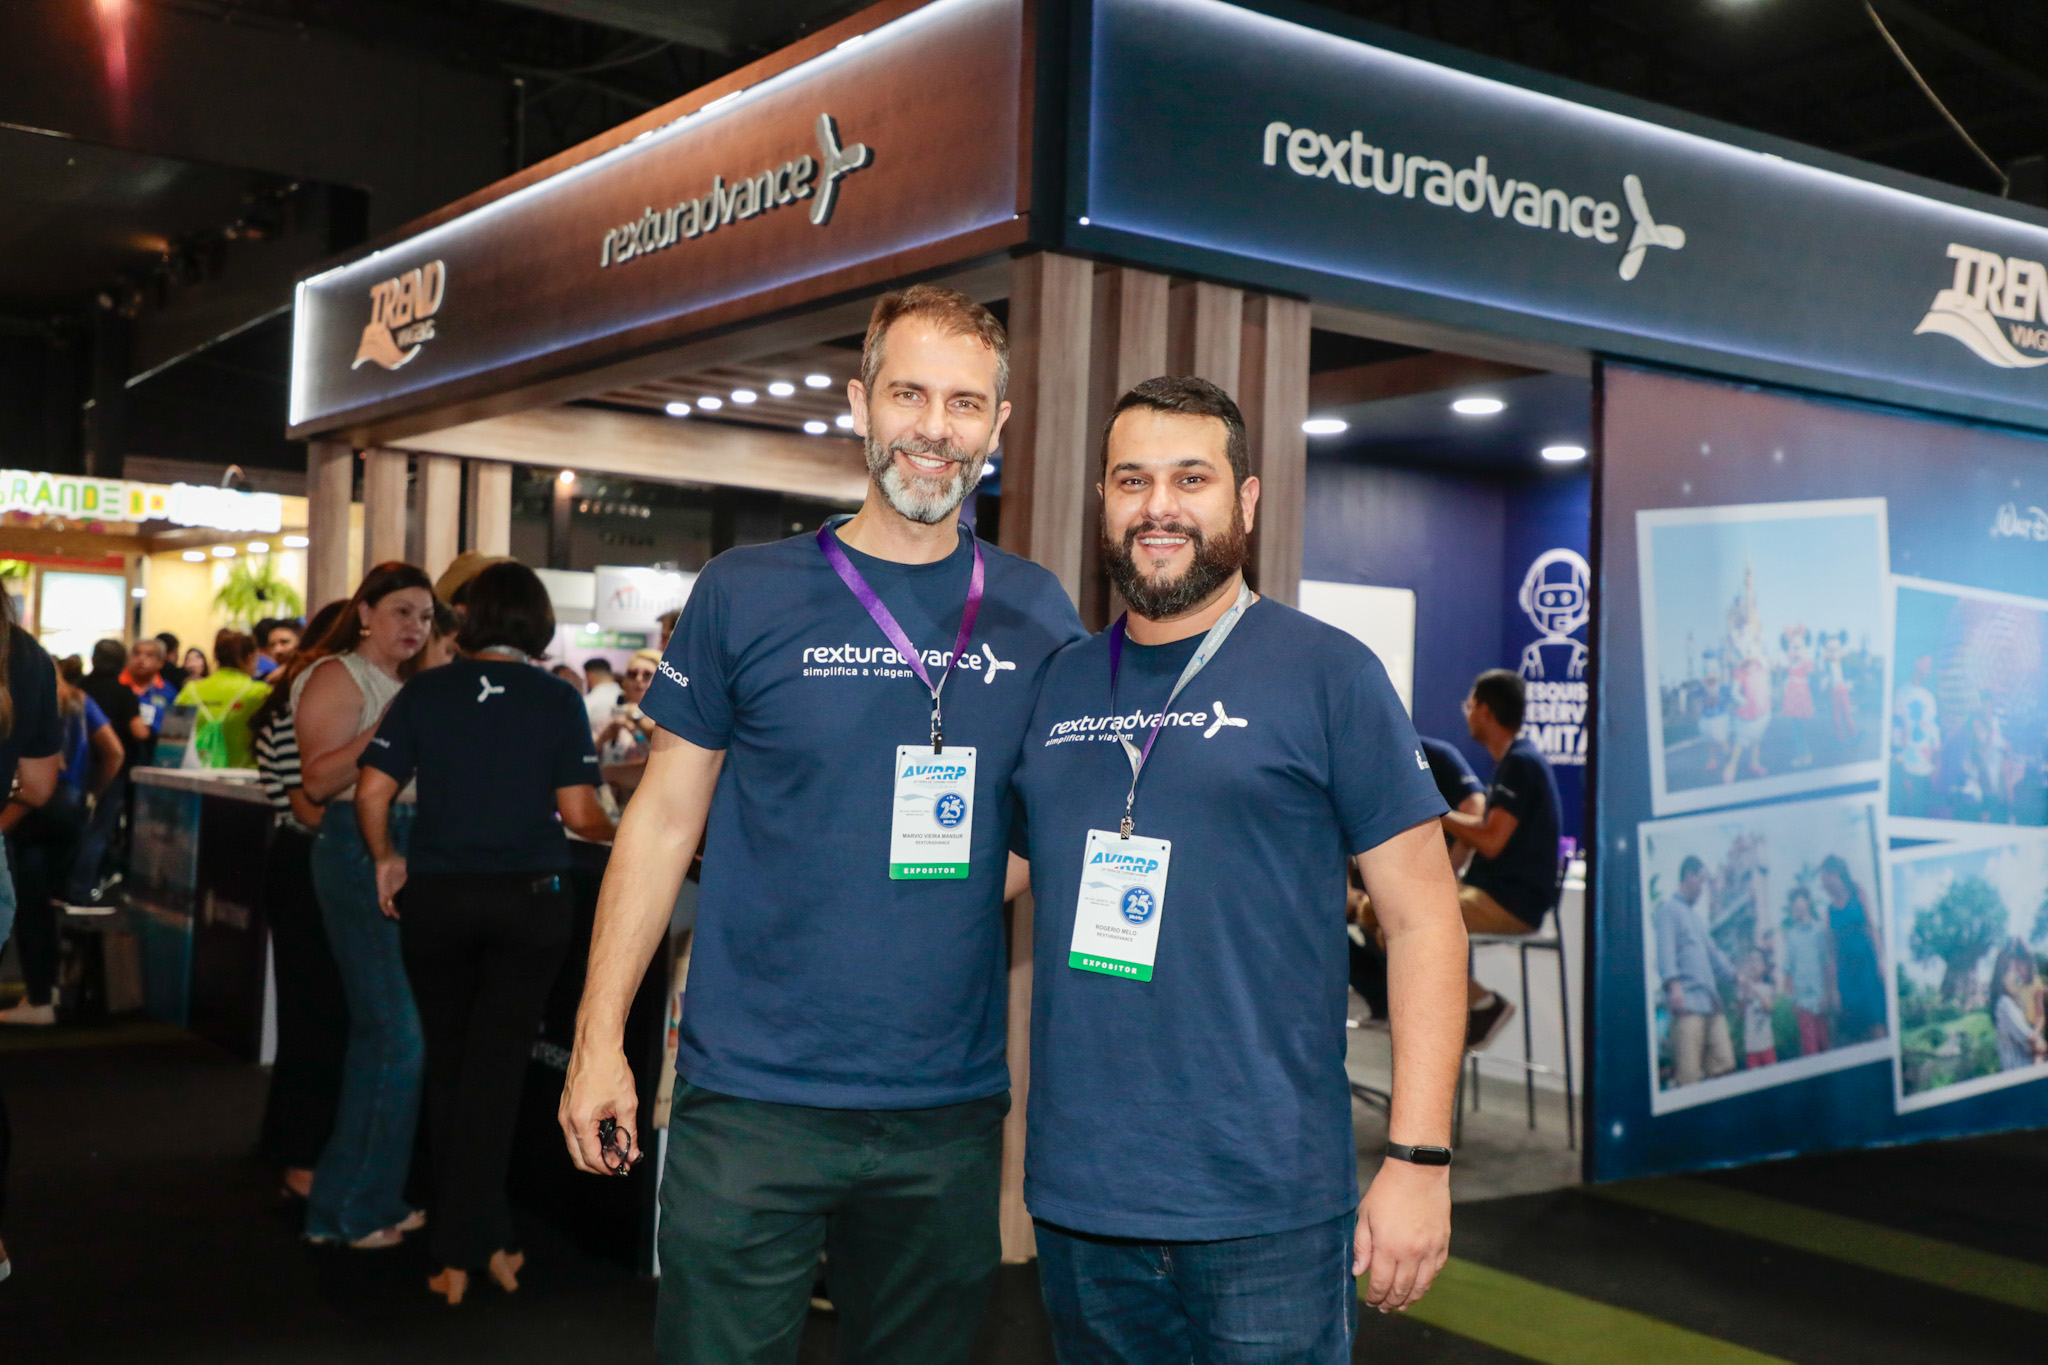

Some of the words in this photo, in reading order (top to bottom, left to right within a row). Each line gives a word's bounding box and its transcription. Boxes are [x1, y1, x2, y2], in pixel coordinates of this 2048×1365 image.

[1263, 121, 1620, 243] rexturadvance
[601, 154, 814, 267] rexturadvance
[370, 259, 445, 331] TREND
[803, 666, 858, 677] simplifica
[874, 667, 913, 679] viagem
[1050, 709, 1207, 736] rexturadvance
[1045, 733, 1085, 747] simplifica
[1082, 958, 1138, 975] EXPOSITOR
